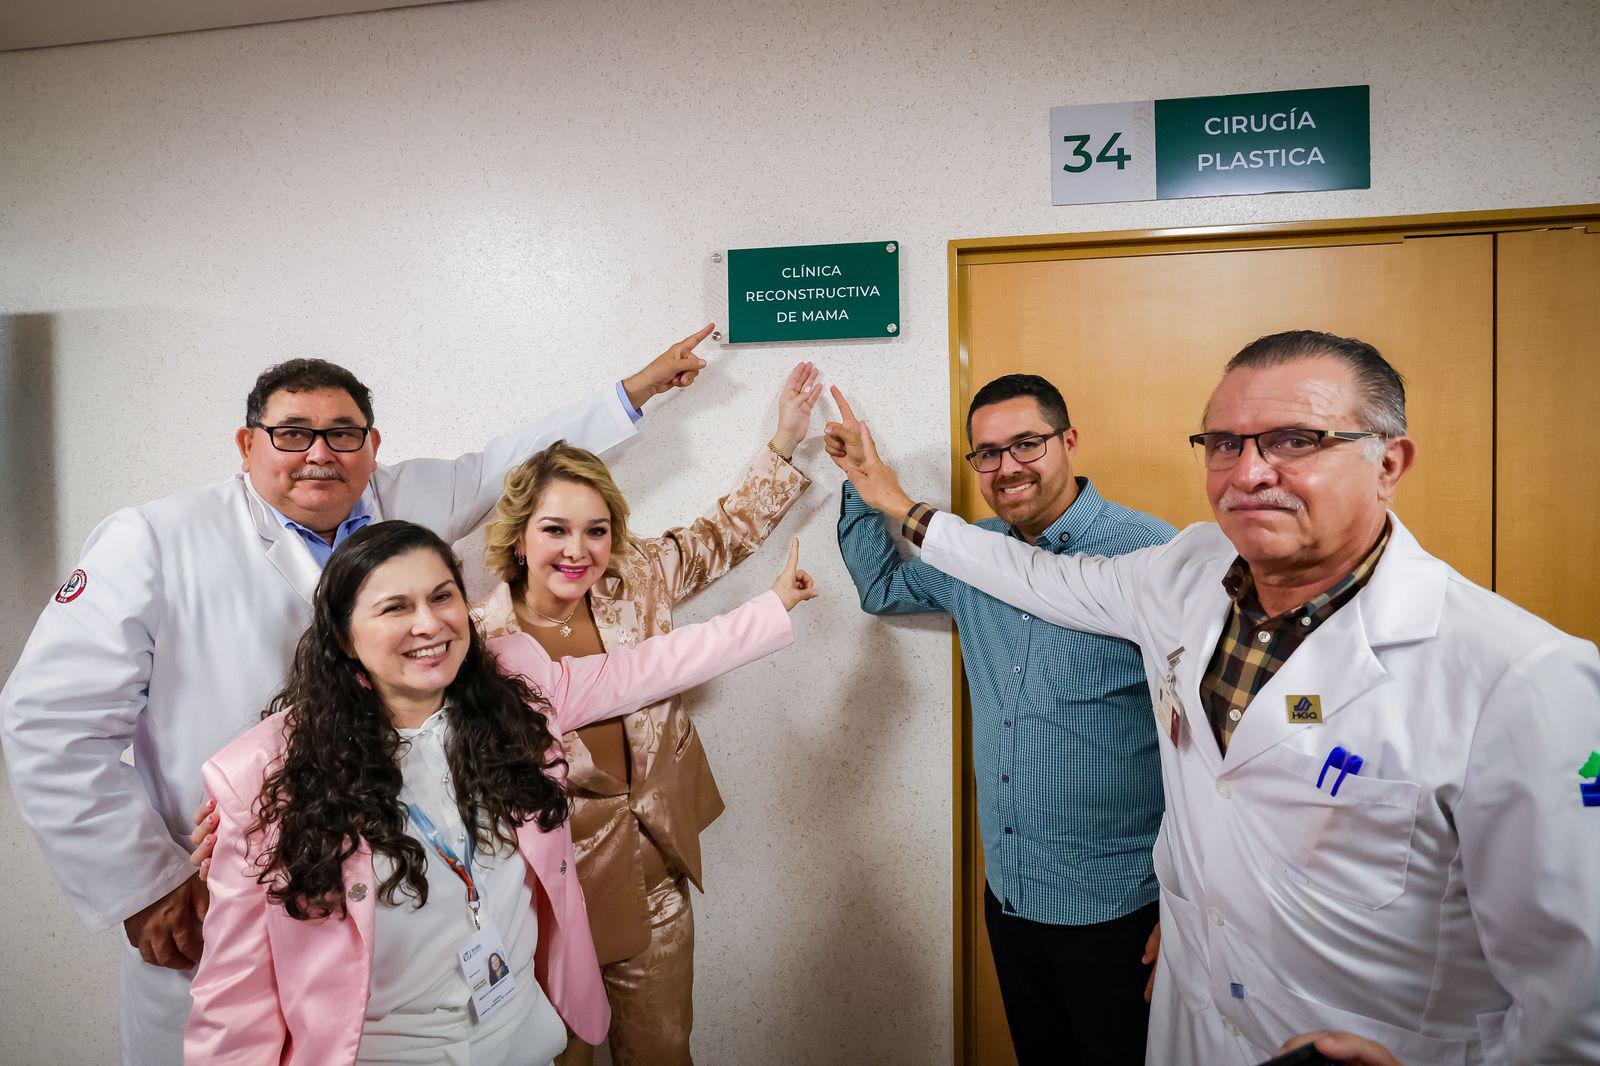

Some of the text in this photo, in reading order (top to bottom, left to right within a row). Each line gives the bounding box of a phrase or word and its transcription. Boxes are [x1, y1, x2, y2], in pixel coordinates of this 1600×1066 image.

[1204, 107, 1317, 136] CIRUGÍA
[1062, 132, 1132, 173] 34
[1197, 146, 1326, 172] PLASTICA
[781, 264, 842, 279] CLÍNICA
[746, 285, 881, 303] RECONSTRUCTIVA
[776, 309, 849, 323] DE MAMA
